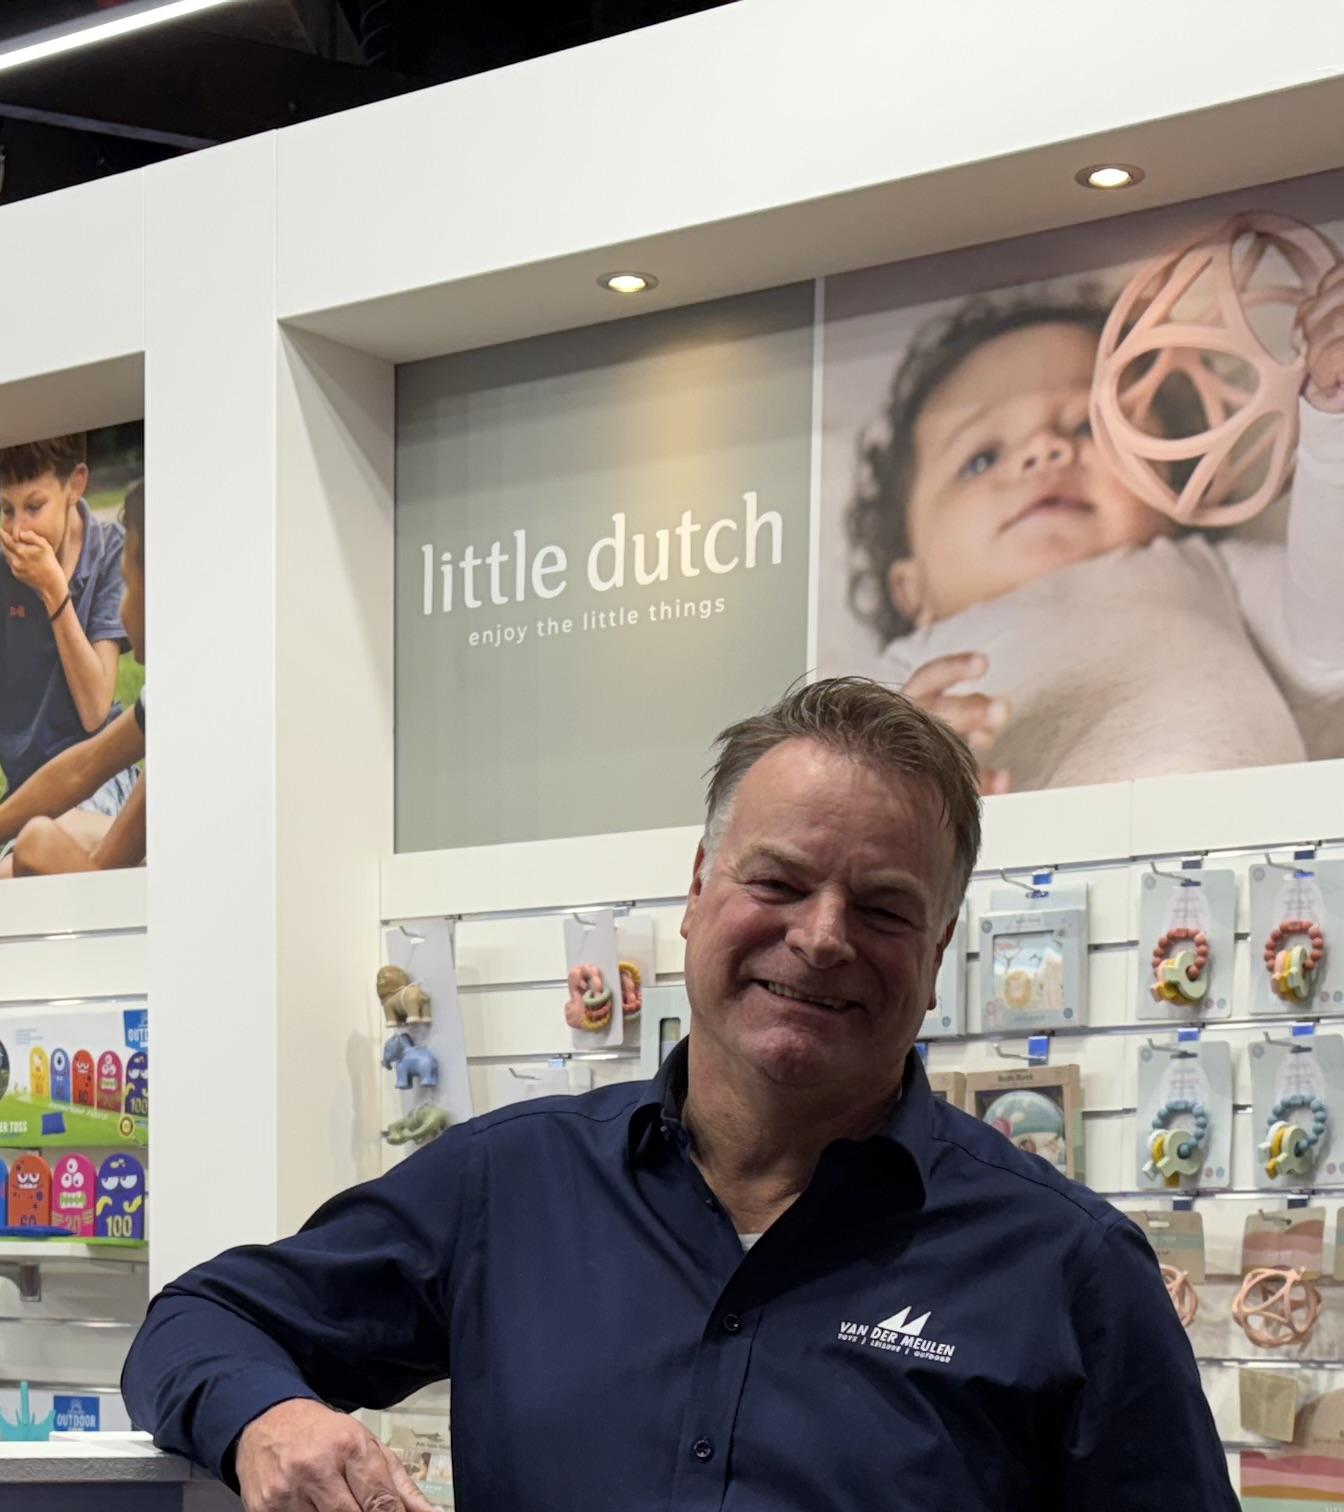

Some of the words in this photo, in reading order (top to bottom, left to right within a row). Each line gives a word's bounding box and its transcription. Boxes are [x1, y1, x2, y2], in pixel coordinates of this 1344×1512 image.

[422, 529, 567, 615] little
[587, 491, 783, 592] dutch
[468, 623, 527, 647] enjoy
[537, 614, 573, 638] the
[583, 606, 639, 631] little
[649, 595, 726, 624] things
[106, 1215, 133, 1237] 100
[840, 1321, 869, 1336] VAN
[870, 1327, 898, 1343] DER
[900, 1335, 956, 1357] MEULEN
[57, 1413, 96, 1429] OUTDOOR
